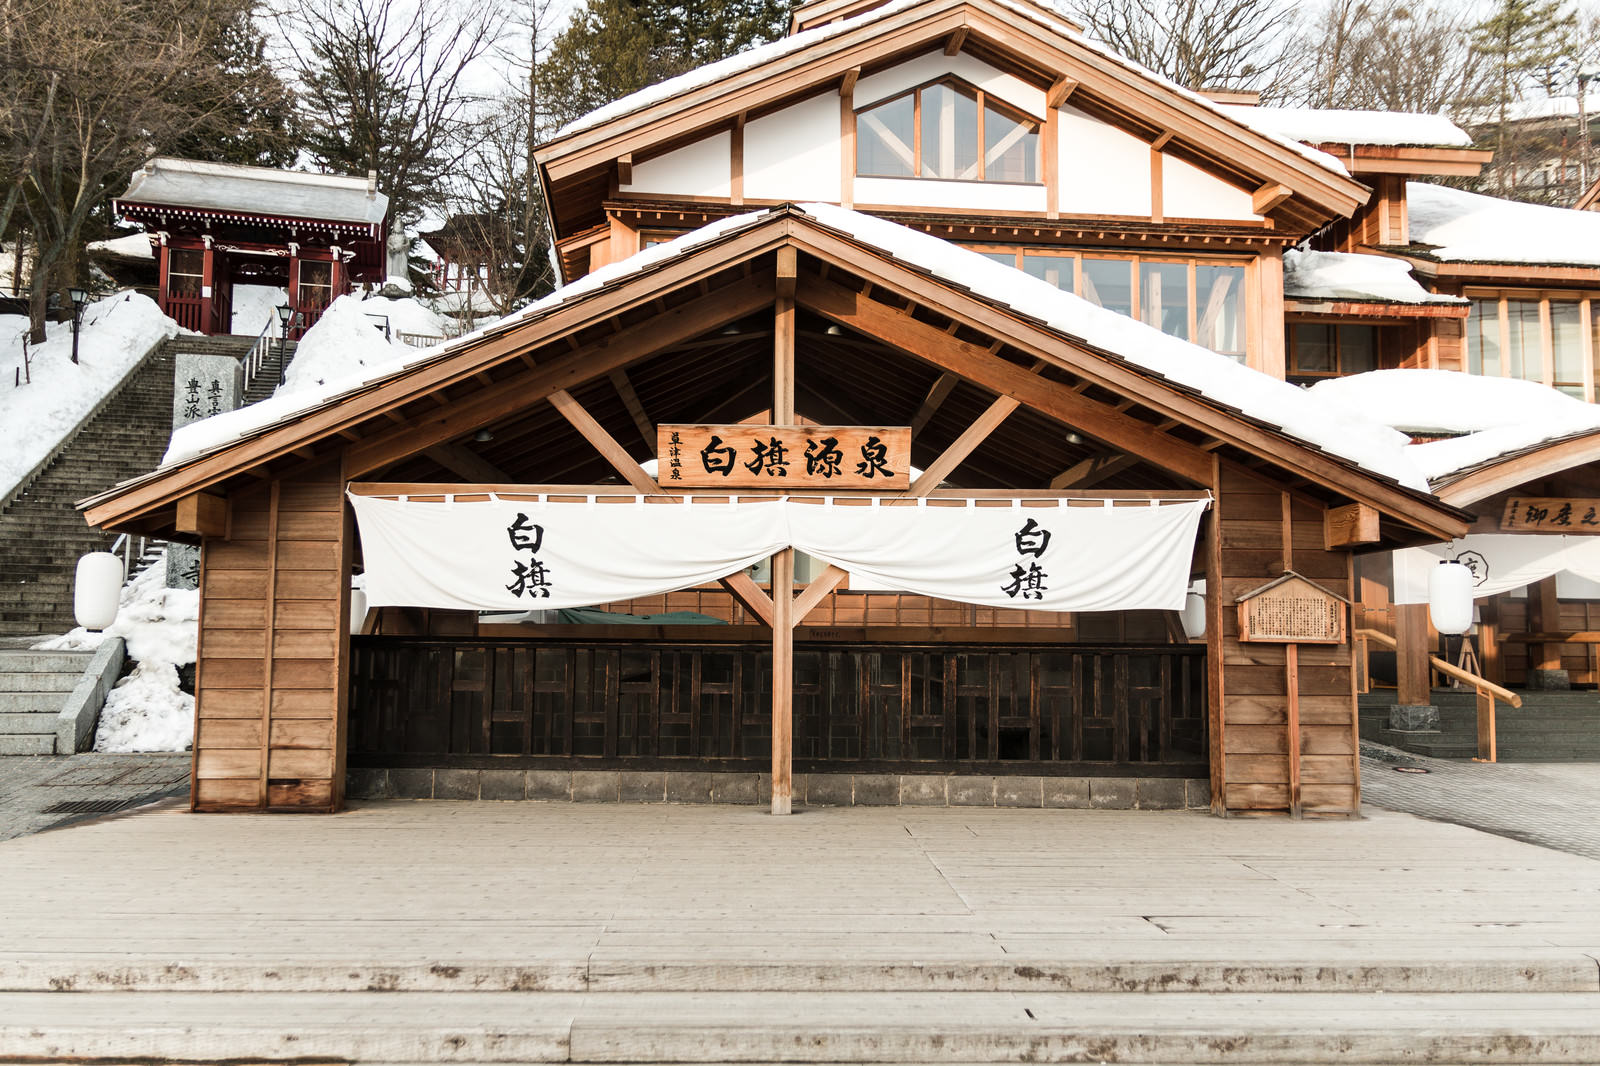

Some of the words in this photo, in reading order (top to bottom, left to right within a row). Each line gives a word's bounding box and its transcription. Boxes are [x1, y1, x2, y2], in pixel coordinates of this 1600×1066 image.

[184, 377, 202, 419] 豊山派
[668, 431, 684, 481] 草津温泉
[700, 435, 895, 479] 白旗源泉
[505, 512, 553, 598] 白旗
[1000, 518, 1052, 600] 白旗
